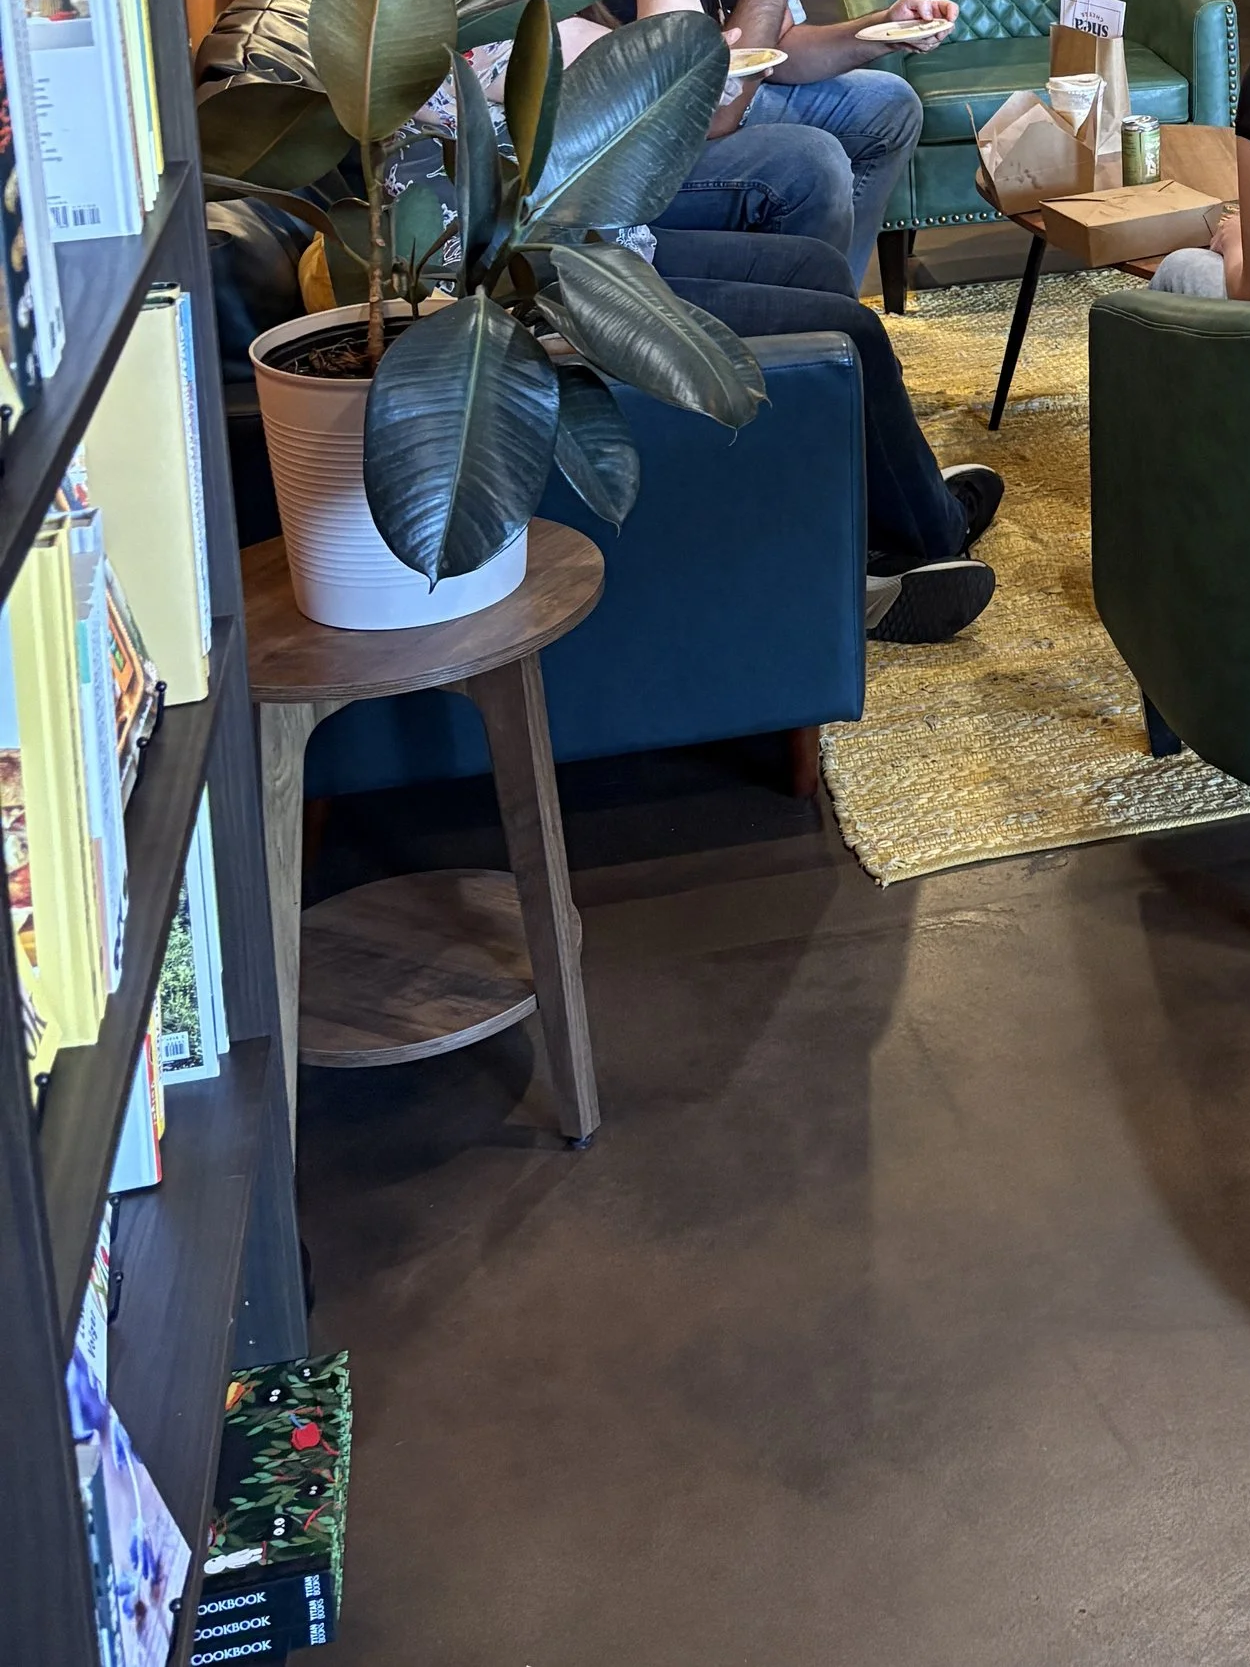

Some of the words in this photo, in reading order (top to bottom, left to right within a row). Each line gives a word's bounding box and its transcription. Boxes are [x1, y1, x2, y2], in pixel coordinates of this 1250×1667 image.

[198, 1591, 267, 1616] OOKBOOK
[303, 1575, 314, 1598] TITAN
[311, 1573, 321, 1597] BOOKS
[308, 1599, 317, 1622] TITAN
[315, 1598, 326, 1620] BOOKS
[190, 1639, 273, 1666] COOKBOOK
[309, 1623, 319, 1646] TITAN
[317, 1622, 327, 1644] BOOKS
